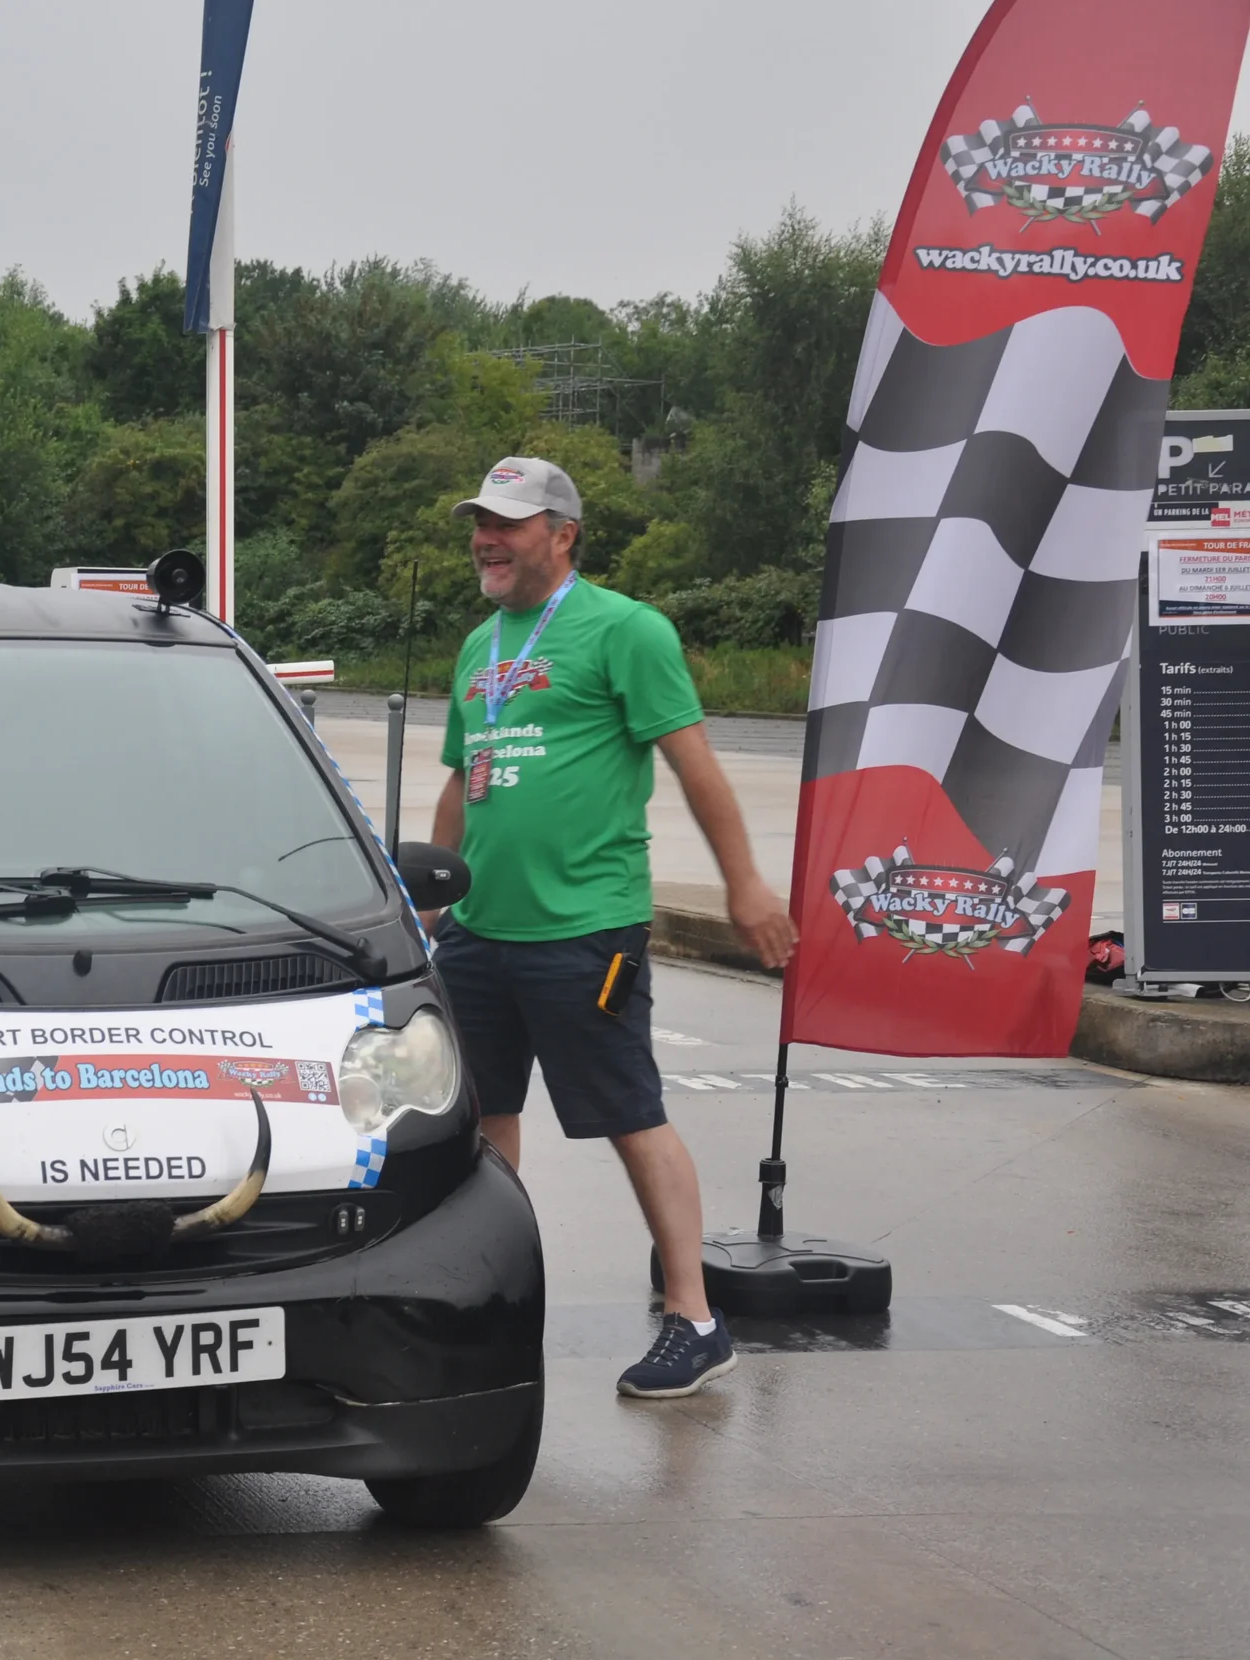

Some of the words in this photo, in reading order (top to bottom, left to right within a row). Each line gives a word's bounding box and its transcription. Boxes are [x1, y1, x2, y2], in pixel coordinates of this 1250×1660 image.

[209, 94, 223, 129] soon
[205, 132, 217, 159] you
[199, 161, 213, 187] See
[984, 155, 1078, 181] Wacky
[1080, 155, 1156, 189] Rally
[915, 246, 1183, 281] wackyrally.co.uk
[1158, 483, 1203, 496] PETIT
[1164, 508, 1190, 516] PARKING
[1204, 542, 1225, 550] TOUR
[1159, 626, 1209, 635] PUBLIC
[1159, 663, 1196, 674] Tarifs
[1198, 666, 1233, 674] (extraits)
[1161, 686, 1172, 694] 15
[1174, 686, 1191, 694] min
[1160, 698, 1172, 706] 30
[1174, 698, 1191, 706] min
[1160, 710, 1172, 718] 45
[1174, 710, 1191, 718] min
[1164, 721, 1170, 729] 1
[1172, 721, 1178, 729] h
[1180, 721, 1191, 729] 00
[1180, 732, 1191, 740] 15
[1172, 744, 1178, 752] h
[1180, 744, 1191, 752] 30
[1164, 756, 1170, 764] 1
[1172, 756, 1178, 764] h
[1180, 756, 1191, 764] 45
[1164, 768, 1170, 776] 2
[1172, 768, 1178, 776] h
[1180, 768, 1191, 776] 00
[1180, 779, 1191, 787] 15
[1164, 791, 1170, 799] 2
[1172, 791, 1178, 799] h
[1180, 791, 1191, 799] 30
[1164, 803, 1170, 811] 2
[1172, 803, 1178, 811] h
[1180, 803, 1191, 811] 45
[1172, 814, 1178, 822] h
[1180, 814, 1191, 822] 00
[1165, 825, 1178, 834] De
[1180, 825, 1208, 834] 12h00
[1210, 824, 1216, 833] à
[1218, 824, 1246, 832] 24h00
[1162, 849, 1222, 857] Abonnement
[869, 892, 950, 916] Wacky
[955, 895, 1020, 928] Rally
[31, 1027, 142, 1045] BORDER
[150, 1027, 273, 1048] CONTROL
[41, 1066, 73, 1090] to
[76, 1062, 210, 1090] Barcelona
[41, 1159, 69, 1184] IS
[79, 1156, 206, 1182] NEEDED
[153, 1318, 260, 1378] YRF
